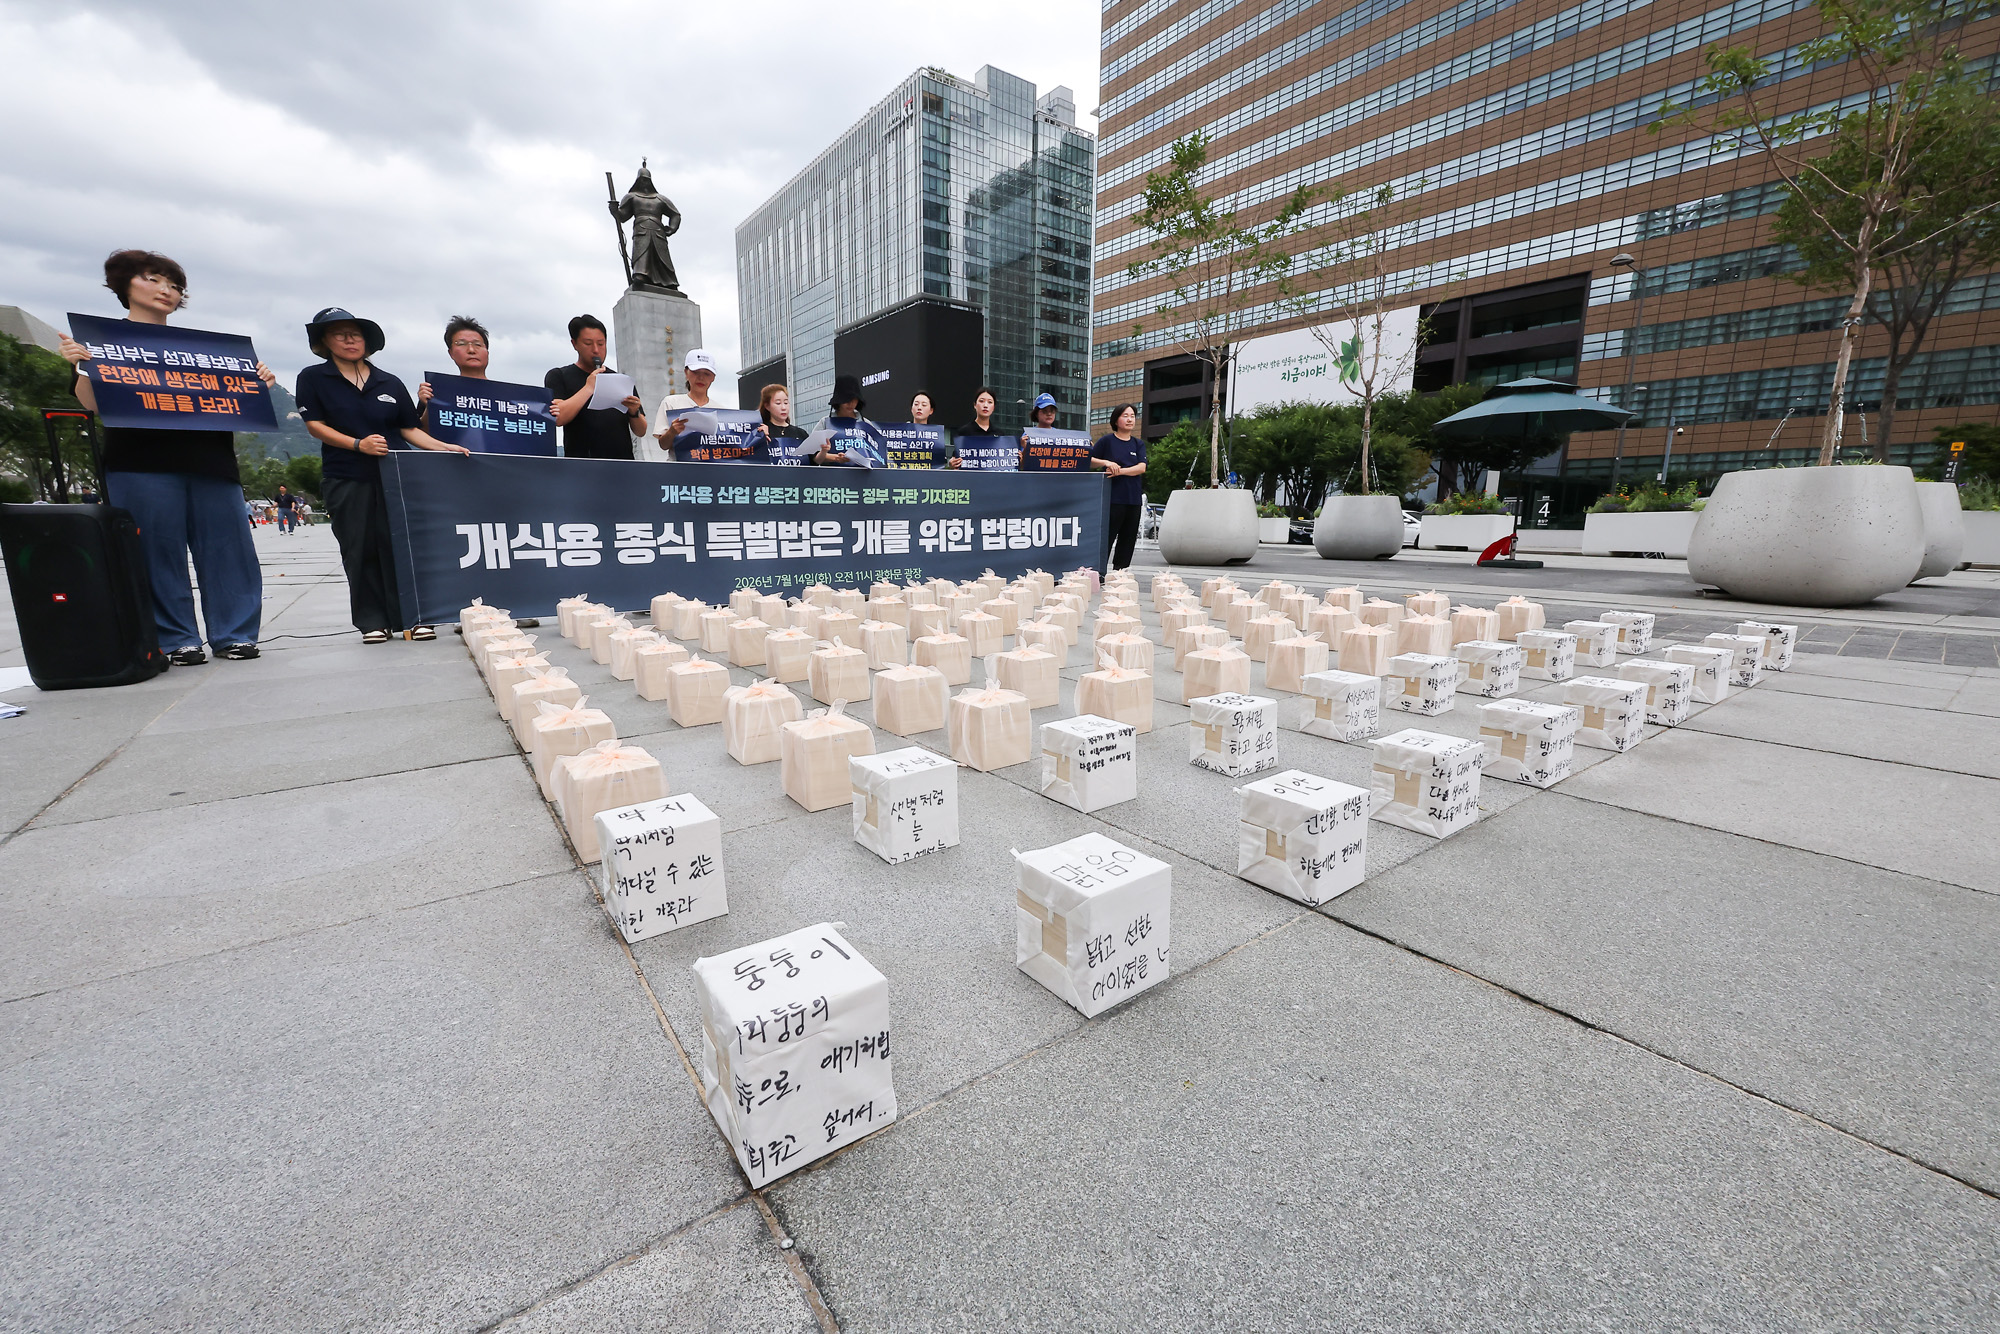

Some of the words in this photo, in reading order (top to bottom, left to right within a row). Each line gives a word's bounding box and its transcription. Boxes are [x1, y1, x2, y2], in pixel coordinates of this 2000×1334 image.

[85, 341, 159, 364] 농림부는
[163, 350, 257, 373] 성과홍보말고
[97, 364, 161, 387] 현장에
[165, 372, 220, 391] 생존해
[224, 375, 260, 394] 있는
[861, 369, 890, 387] SAMSUNG
[1281, 363, 1327, 383] 지금이야!
[135, 391, 195, 413] 개들을
[200, 395, 241, 415] 보라!
[456, 395, 492, 411] 방치된
[494, 399, 530, 416] 개농장
[439, 409, 500, 432] 방관하는
[503, 417, 548, 436] 농림부
[881, 430, 917, 438] 식용종식법
[700, 434, 742, 445] 사형선고다
[690, 448, 710, 460] 학살
[1029, 447, 1051, 457] 현장에
[1052, 447, 1074, 457] 생존해
[1075, 448, 1089, 458] 있는
[1061, 459, 1078, 469] 보라!
[660, 484, 713, 504] 개식용
[717, 485, 750, 504] 산업
[753, 486, 799, 504] 생존견
[803, 486, 859, 504] 외면하는
[862, 487, 890, 504] 정부
[892, 487, 919, 504] 규탄
[921, 487, 971, 505] 기자회견
[1538, 501, 1551, 518] 4
[455, 522, 603, 570] 개식용
[613, 520, 697, 564] 종식
[705, 519, 843, 561] 특별법은
[851, 518, 911, 555] 개를
[919, 517, 975, 553] 위한
[981, 516, 1082, 551] 법령이다
[734, 574, 773, 589] 2026년
[775, 573, 792, 588] 7월
[794, 571, 832, 587] 14일(화)
[834, 570, 854, 583] 오전
[856, 569, 873, 583] 11시
[875, 568, 902, 581] 광화문
[904, 567, 922, 580] 광장
[1231, 708, 1265, 734] 왕처럼
[1344, 710, 1360, 727] 가장
[1229, 739, 1251, 756] 하고
[1255, 731, 1274, 753] 싶은
[1273, 777, 1324, 795] 이안
[891, 789, 944, 822] 샛별처럼
[912, 820, 923, 842] 늘
[666, 863, 680, 885] 수
[688, 854, 716, 880] 있는
[655, 895, 702, 925] 가족과
[1124, 913, 1153, 947] 선한
[733, 936, 851, 991] 둥둥이
[1092, 954, 1149, 1001] 아이였을
[820, 1030, 891, 1074] 애기처럼
